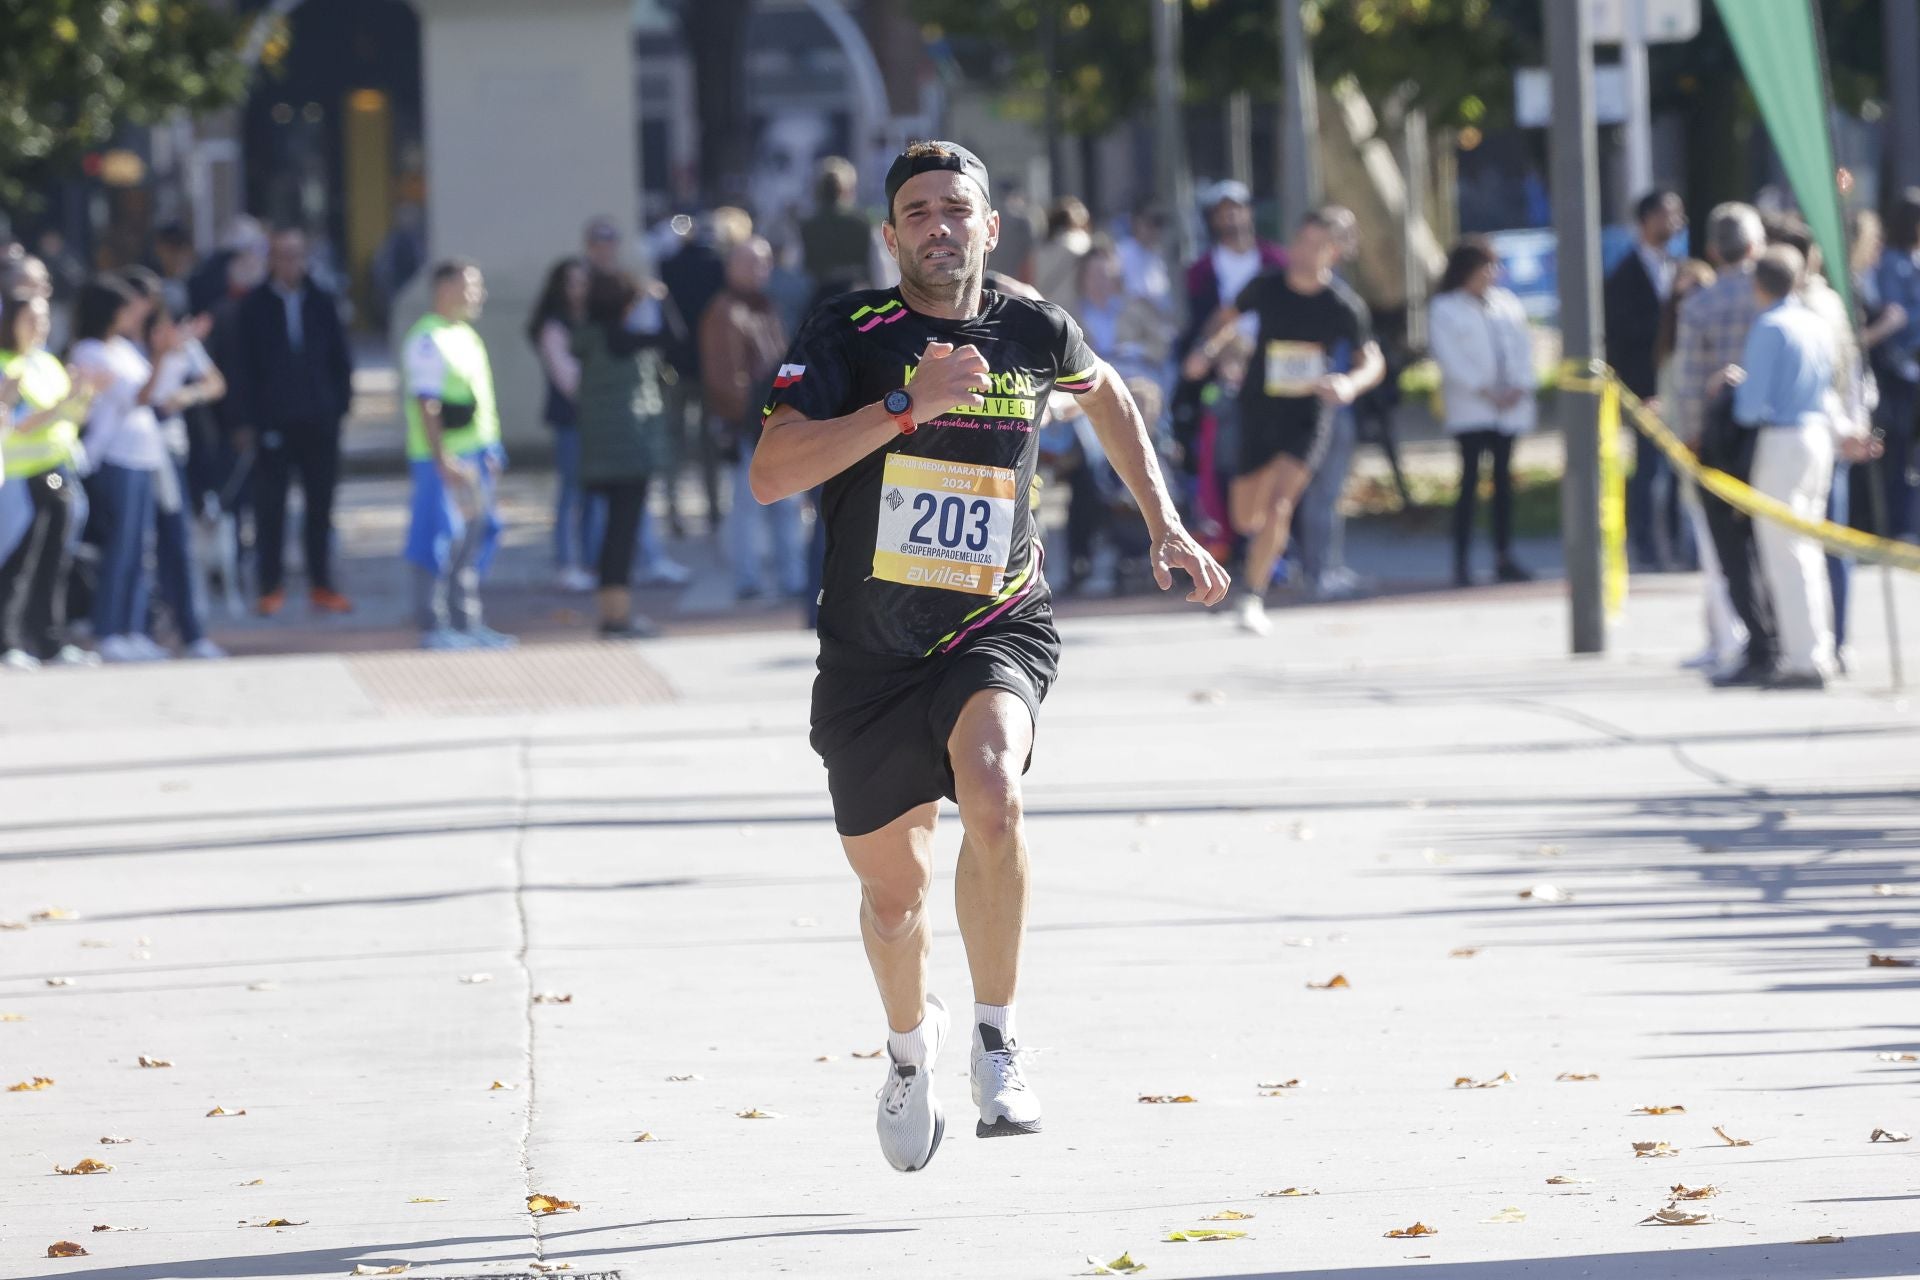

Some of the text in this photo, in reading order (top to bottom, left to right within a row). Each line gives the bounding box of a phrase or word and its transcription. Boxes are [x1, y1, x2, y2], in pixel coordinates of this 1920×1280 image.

[918, 461, 947, 472] MEDIA
[942, 477, 972, 490] 2024
[909, 492, 991, 552] 203
[900, 543, 992, 564] @SUPERPAPADEMELLIZAS
